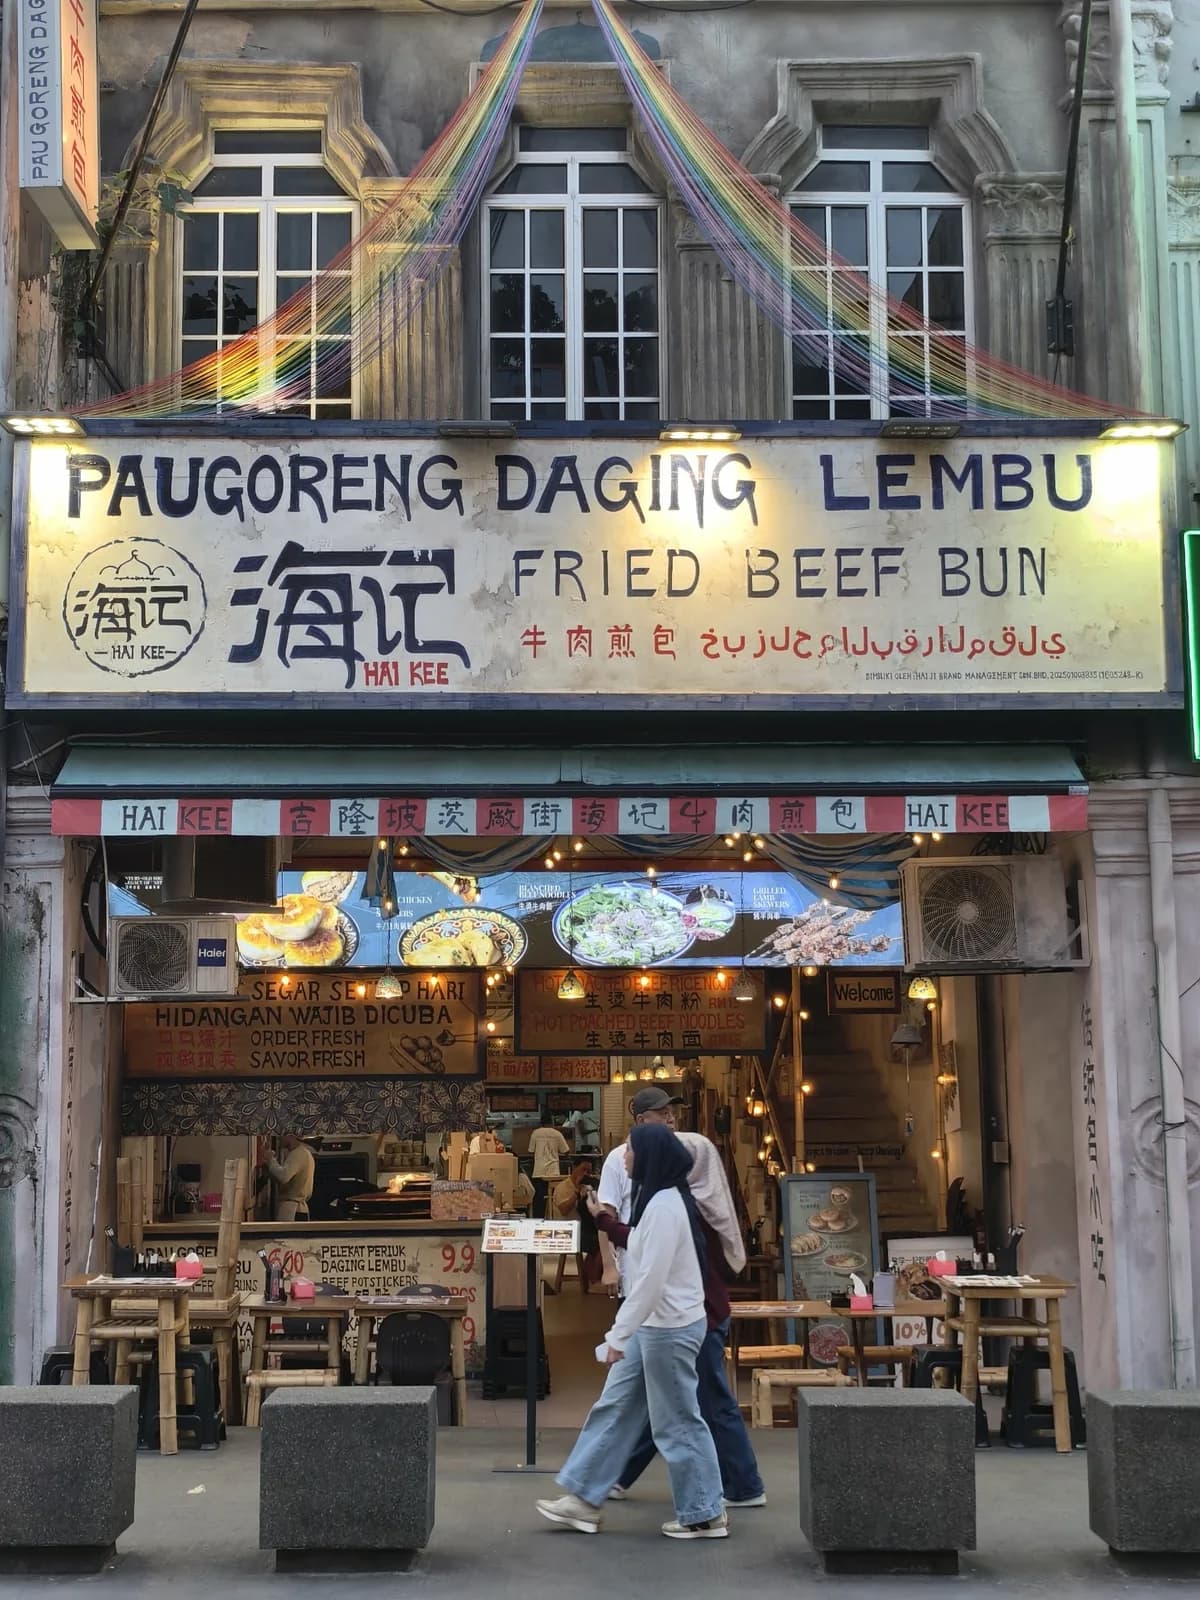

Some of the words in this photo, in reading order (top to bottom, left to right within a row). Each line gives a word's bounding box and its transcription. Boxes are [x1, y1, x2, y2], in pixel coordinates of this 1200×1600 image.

[66, 452, 464, 523] PAUGORENG
[495, 452, 758, 528] DAGING
[820, 453, 1093, 512] LEMBU
[512, 549, 701, 601] FRIED
[746, 547, 904, 599] BEEF
[938, 547, 1046, 598] BUN
[112, 646, 134, 660] HAI
[141, 646, 165, 660] KEE
[520, 624, 677, 661] 牛肉煎包
[364, 662, 400, 687] HAI
[409, 661, 449, 687] KEE
[122, 804, 167, 832] HAI
[179, 805, 231, 832] KEE
[908, 803, 949, 828] HAI
[963, 802, 1008, 828] KEE
[198, 948, 226, 958] Haier
[251, 980, 320, 1001] SEGAR
[417, 980, 466, 1001] HARI
[834, 981, 894, 1002] Welcome
[155, 1005, 282, 1029] HIDANGAN
[290, 1004, 356, 1026] WAJIB
[365, 1004, 453, 1026] DICUBA
[534, 1014, 563, 1032] HOT
[569, 1013, 636, 1032] POACHED
[639, 1013, 676, 1031] BEEF
[679, 1012, 746, 1031] NOODLES
[250, 1030, 308, 1047] ORDER
[311, 1030, 366, 1047] FRESH
[249, 1050, 310, 1069] SAVOR
[311, 1050, 366, 1068] FRESH
[321, 1245, 366, 1259] PELEKAT
[367, 1245, 406, 1258] PERIUK
[321, 1259, 365, 1274] DAGING
[367, 1259, 406, 1273] LEMBU
[895, 1320, 927, 1341] 10%
